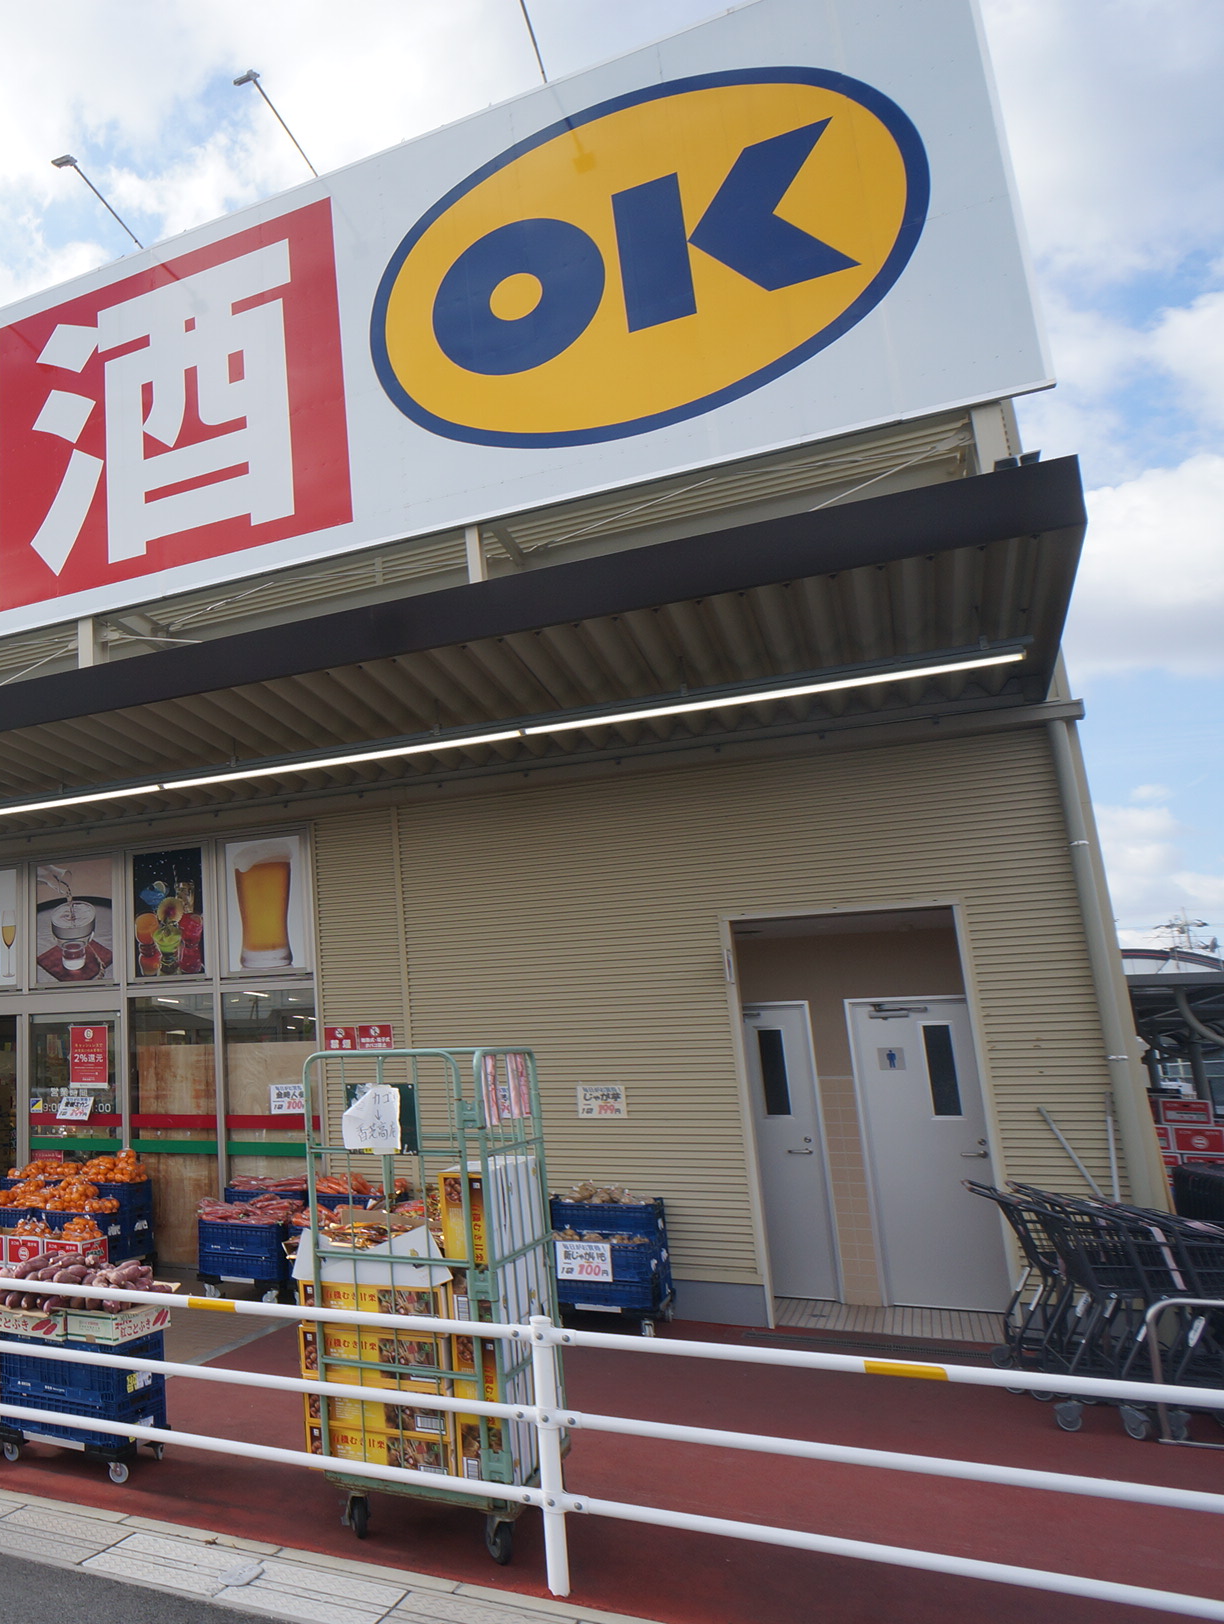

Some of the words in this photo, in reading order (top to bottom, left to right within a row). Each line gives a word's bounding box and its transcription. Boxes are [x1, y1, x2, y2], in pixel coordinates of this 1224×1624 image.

[433, 116, 862, 377] OK
[31, 239, 295, 577] 酒
[74, 1054, 104, 1063] 2%還元
[583, 1093, 622, 1102] じゃが芋
[563, 1250, 607, 1262] 新じゃがいも
[120, 1318, 151, 1338] 紅ことぶき
